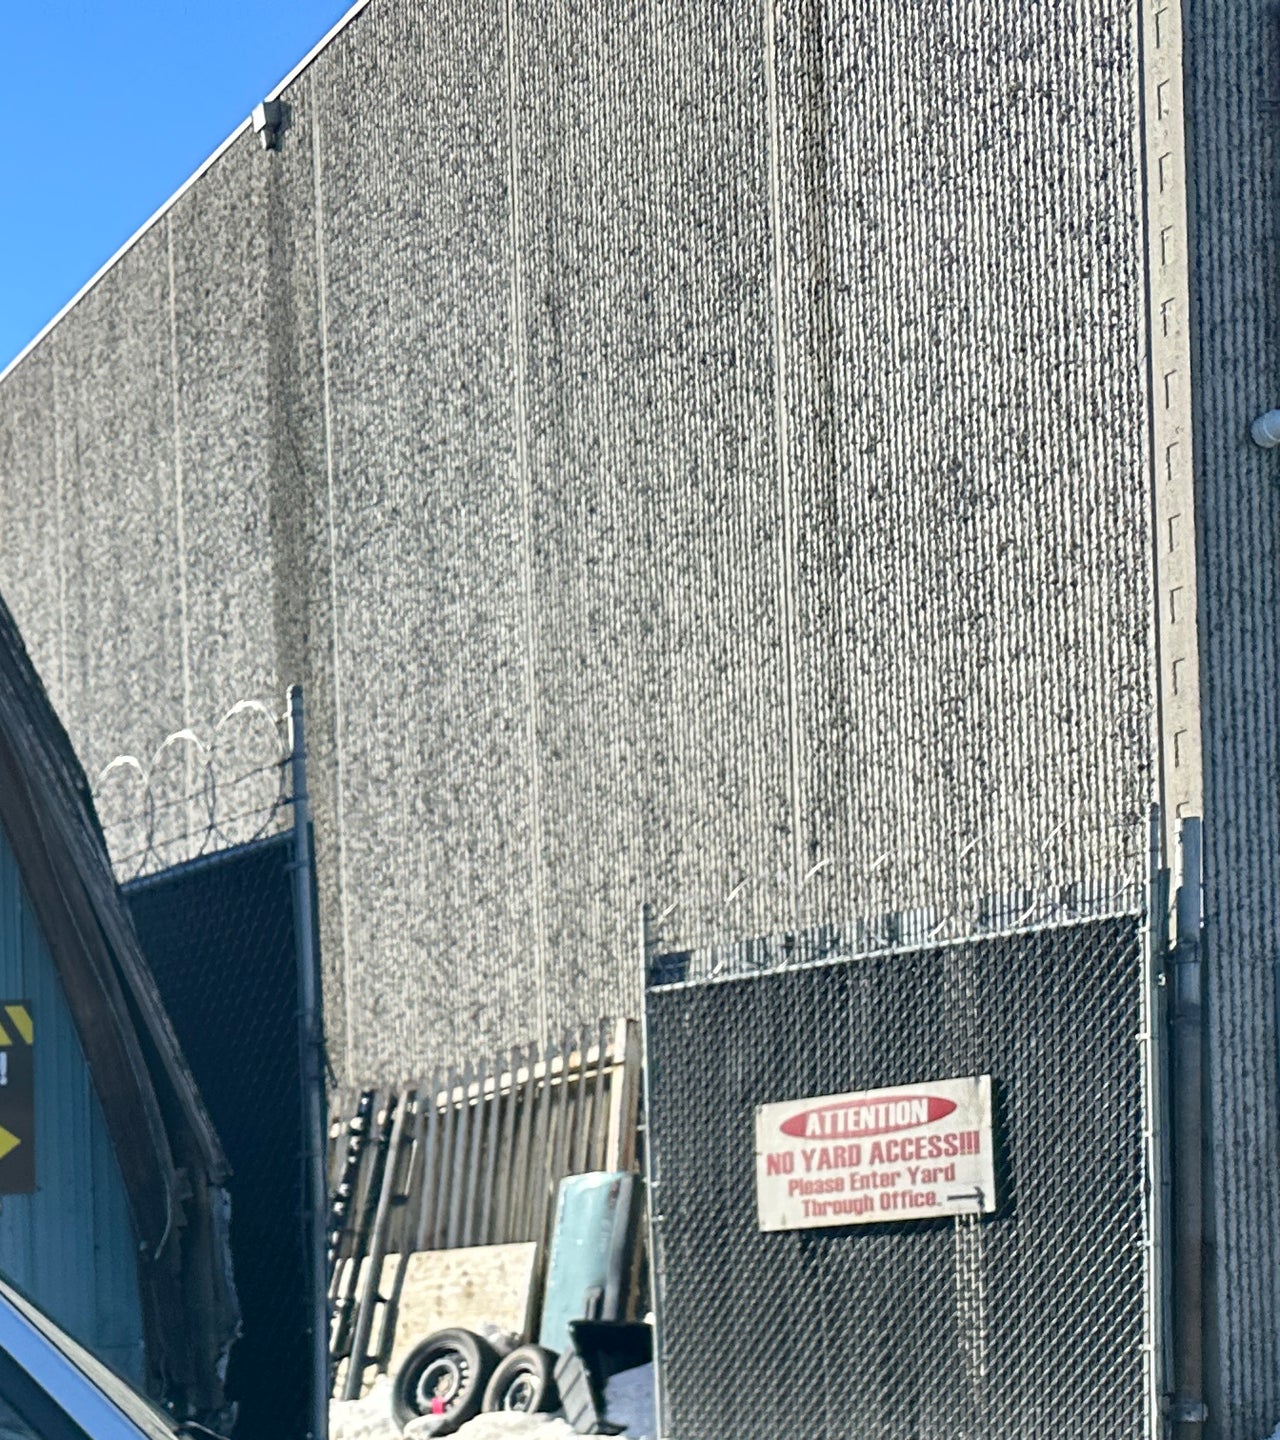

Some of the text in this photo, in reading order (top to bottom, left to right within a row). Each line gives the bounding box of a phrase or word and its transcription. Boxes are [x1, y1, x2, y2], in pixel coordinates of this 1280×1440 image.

[804, 1098, 929, 1137] ATTENTION
[766, 1130, 981, 1177] NO YARD ACCESS!!!
[788, 1162, 956, 1198] Please Enter Yard
[801, 1193, 875, 1218] Through
